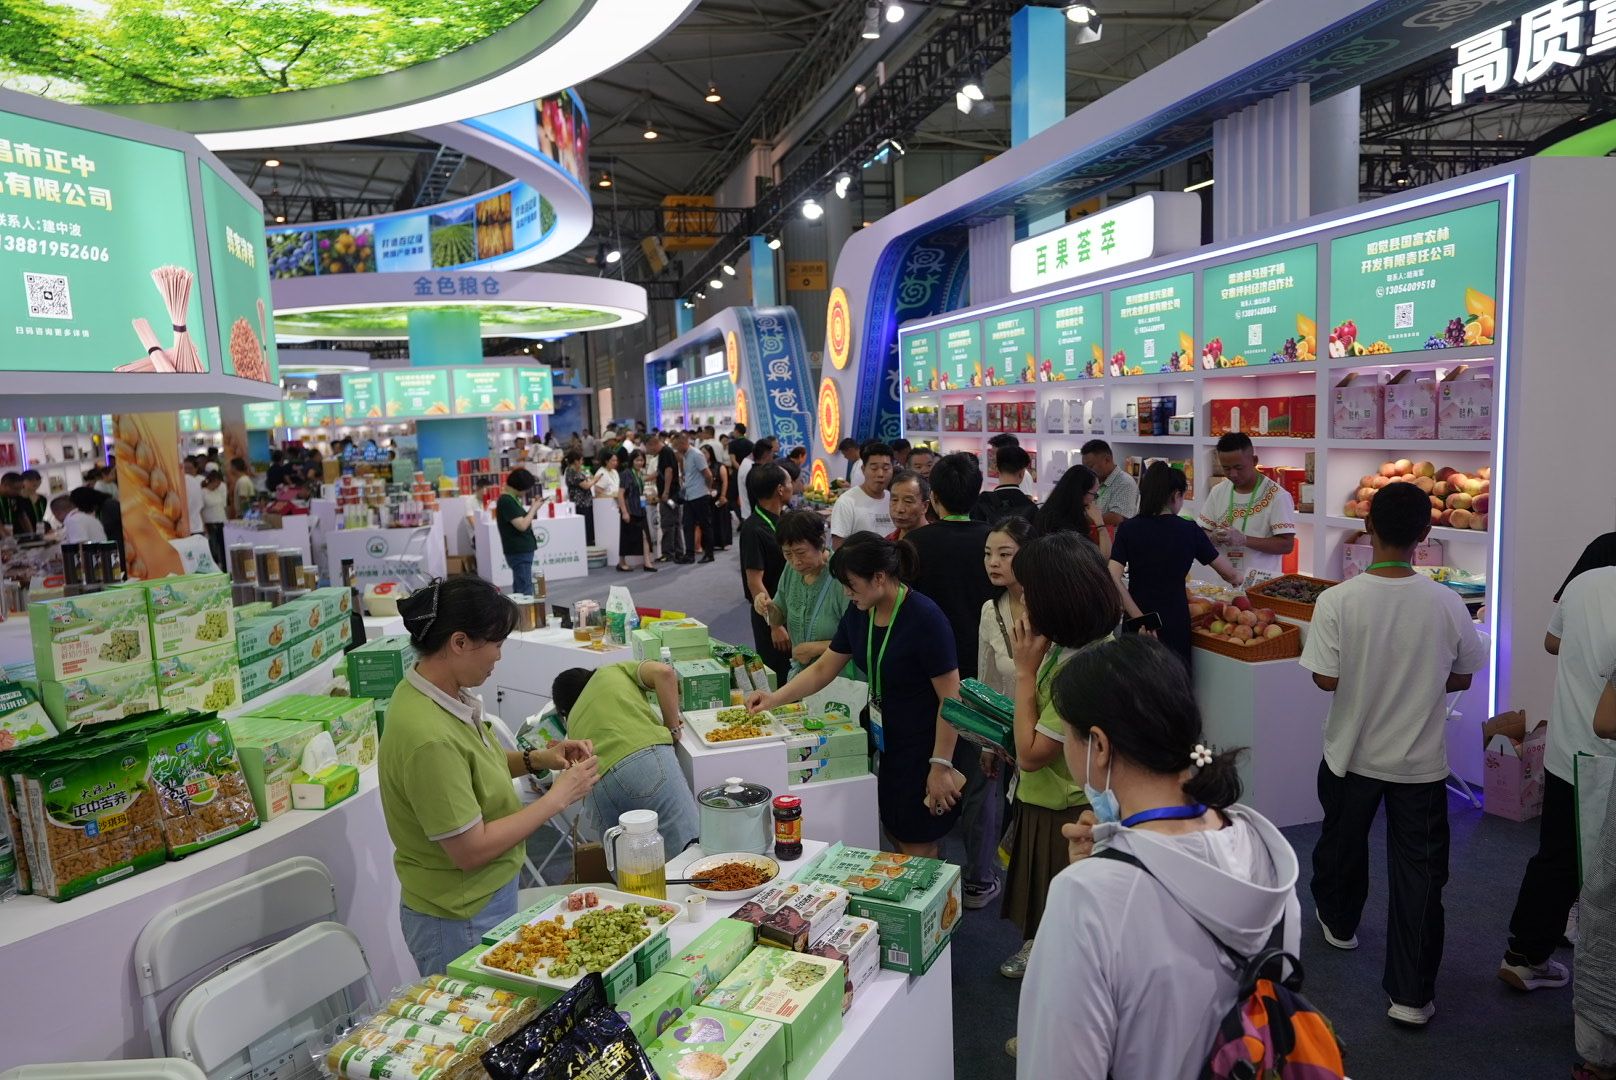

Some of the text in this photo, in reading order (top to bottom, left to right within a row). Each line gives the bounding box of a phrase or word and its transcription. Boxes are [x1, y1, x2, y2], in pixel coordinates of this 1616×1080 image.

[0, 138, 95, 178] 昌市正中
[0, 172, 113, 212] 有限公司
[0, 234, 109, 262] 3881952606
[1036, 220, 1116, 275] 百果荟萃
[1361, 244, 1456, 273] 开发有限责任公司
[413, 276, 500, 296] 金色粮仓
[15, 326, 90, 337] 扫码咨询更多详情
[73, 790, 129, 818] 正中苦荞
[99, 813, 128, 831] 沙琪玛
